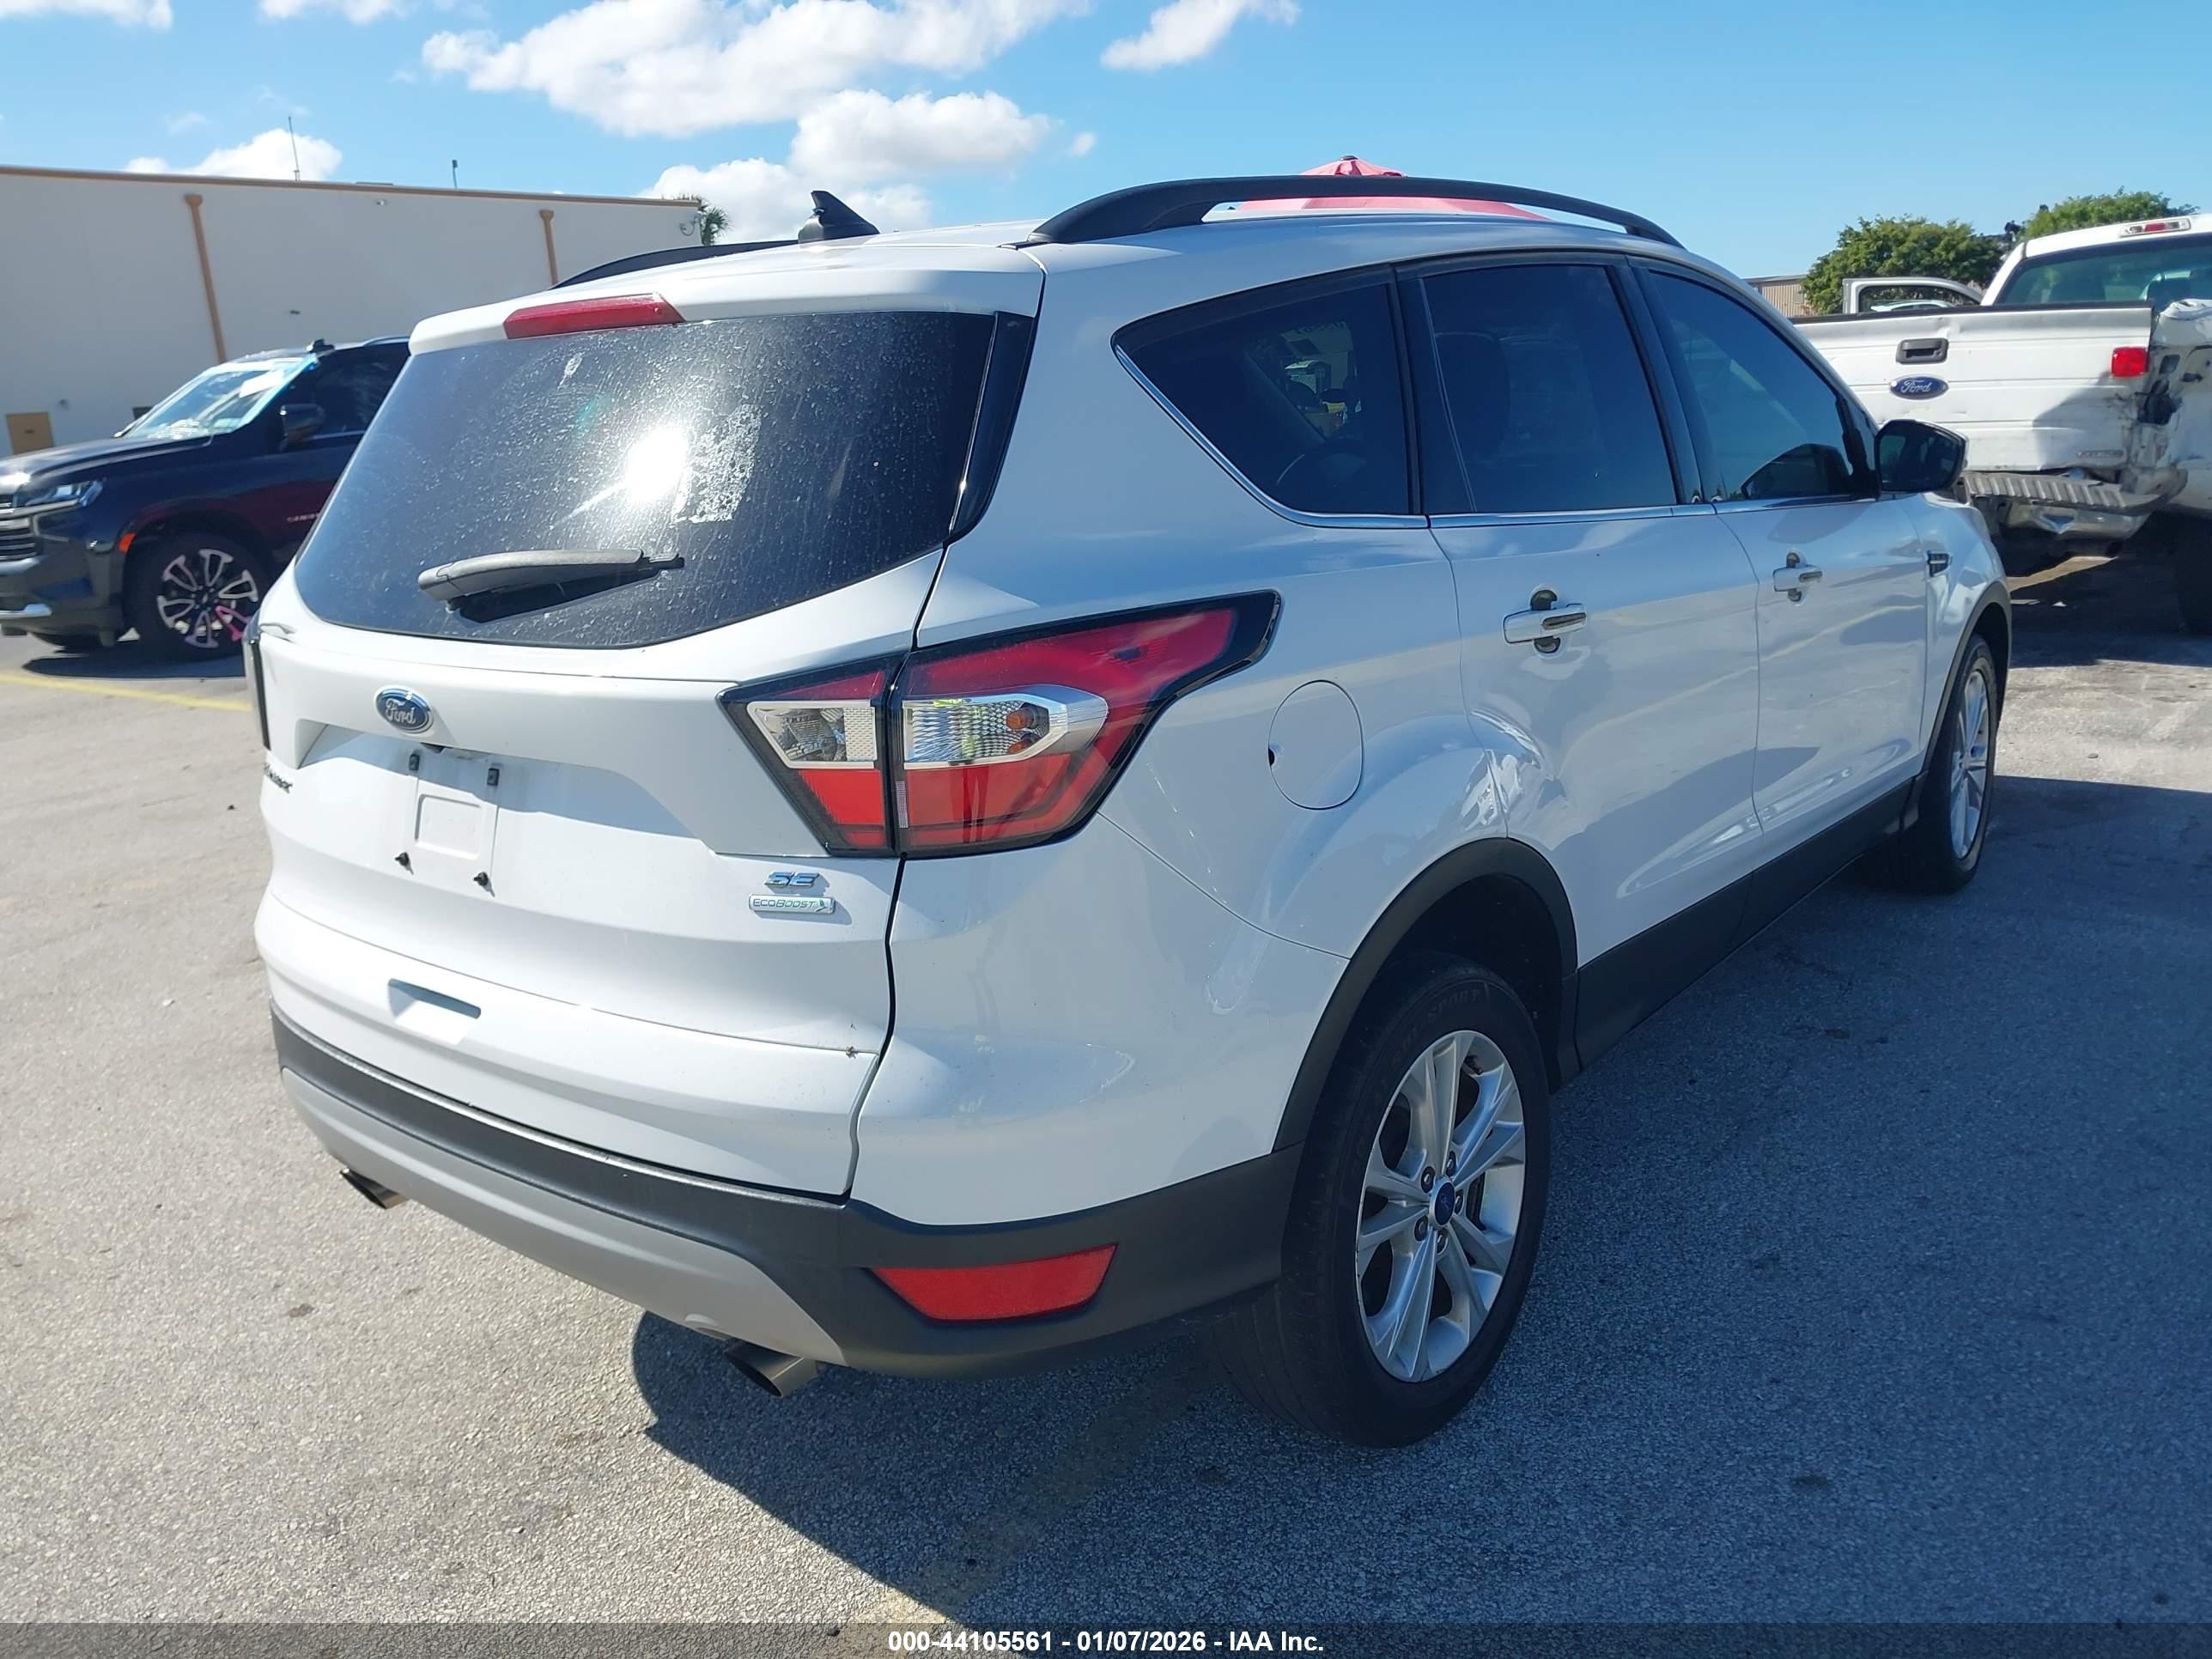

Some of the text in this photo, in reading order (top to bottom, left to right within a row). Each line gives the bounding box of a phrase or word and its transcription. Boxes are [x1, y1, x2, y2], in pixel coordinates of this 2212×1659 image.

[1900, 379, 1932, 392] Ford
[386, 698, 416, 724] Ford
[763, 872, 820, 887] SE
[753, 898, 816, 908] ECOBOOST
